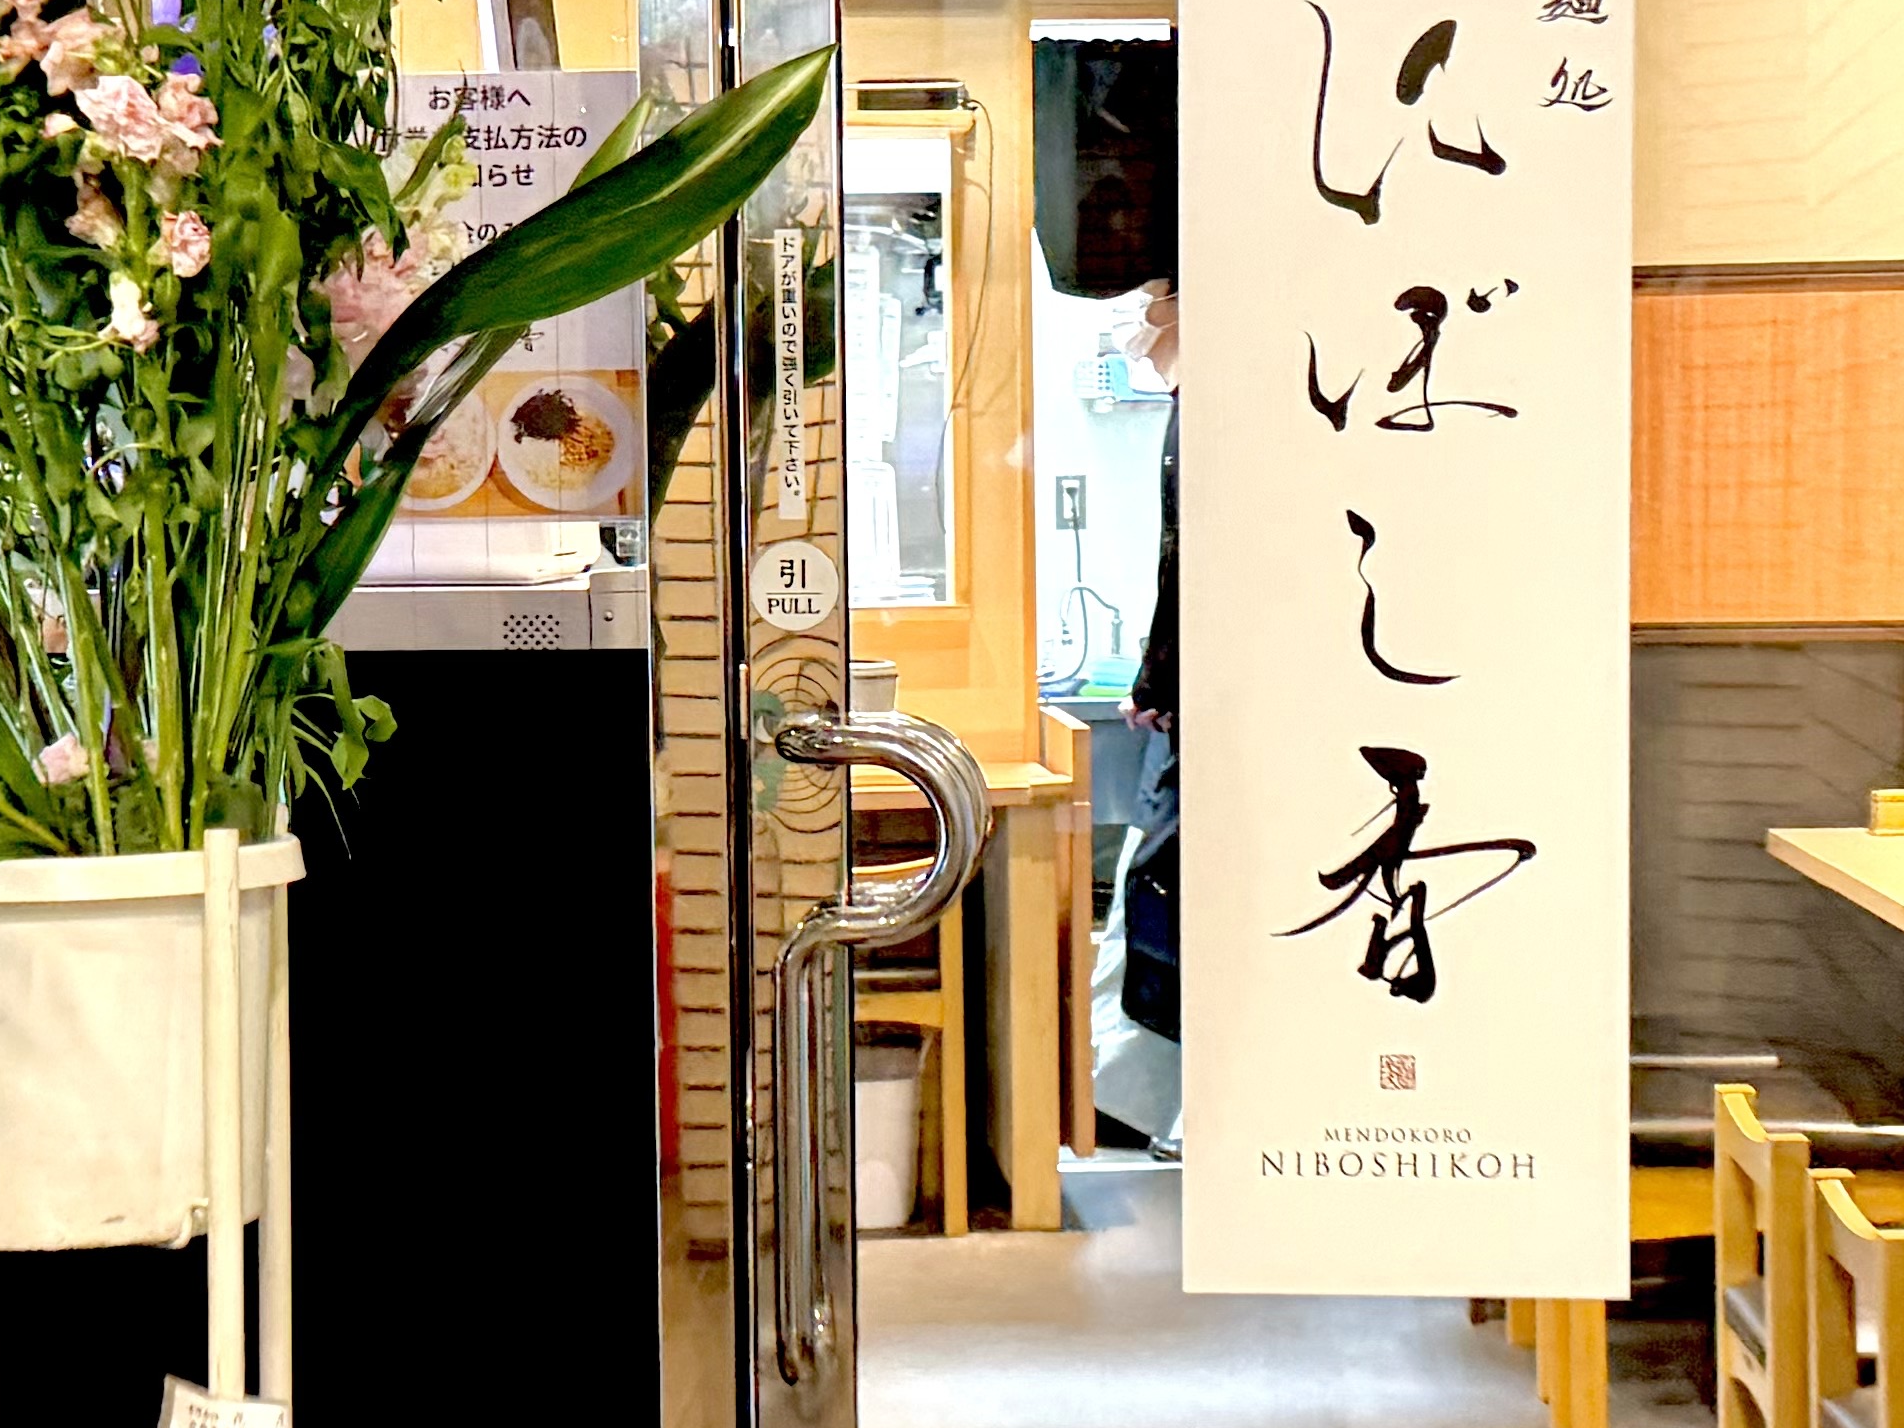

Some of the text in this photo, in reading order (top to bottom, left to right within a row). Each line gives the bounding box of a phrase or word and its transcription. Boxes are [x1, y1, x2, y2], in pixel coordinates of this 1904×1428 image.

[429, 85, 531, 111] お客様へ
[380, 125, 588, 151] 支払方法の
[1273, 0, 1537, 1004] にぼし香
[780, 559, 807, 589] 引
[767, 597, 820, 615] PULL
[1325, 1127, 1472, 1144] MENDOKORO
[1262, 1150, 1535, 1179] NIBOSHIKOH
